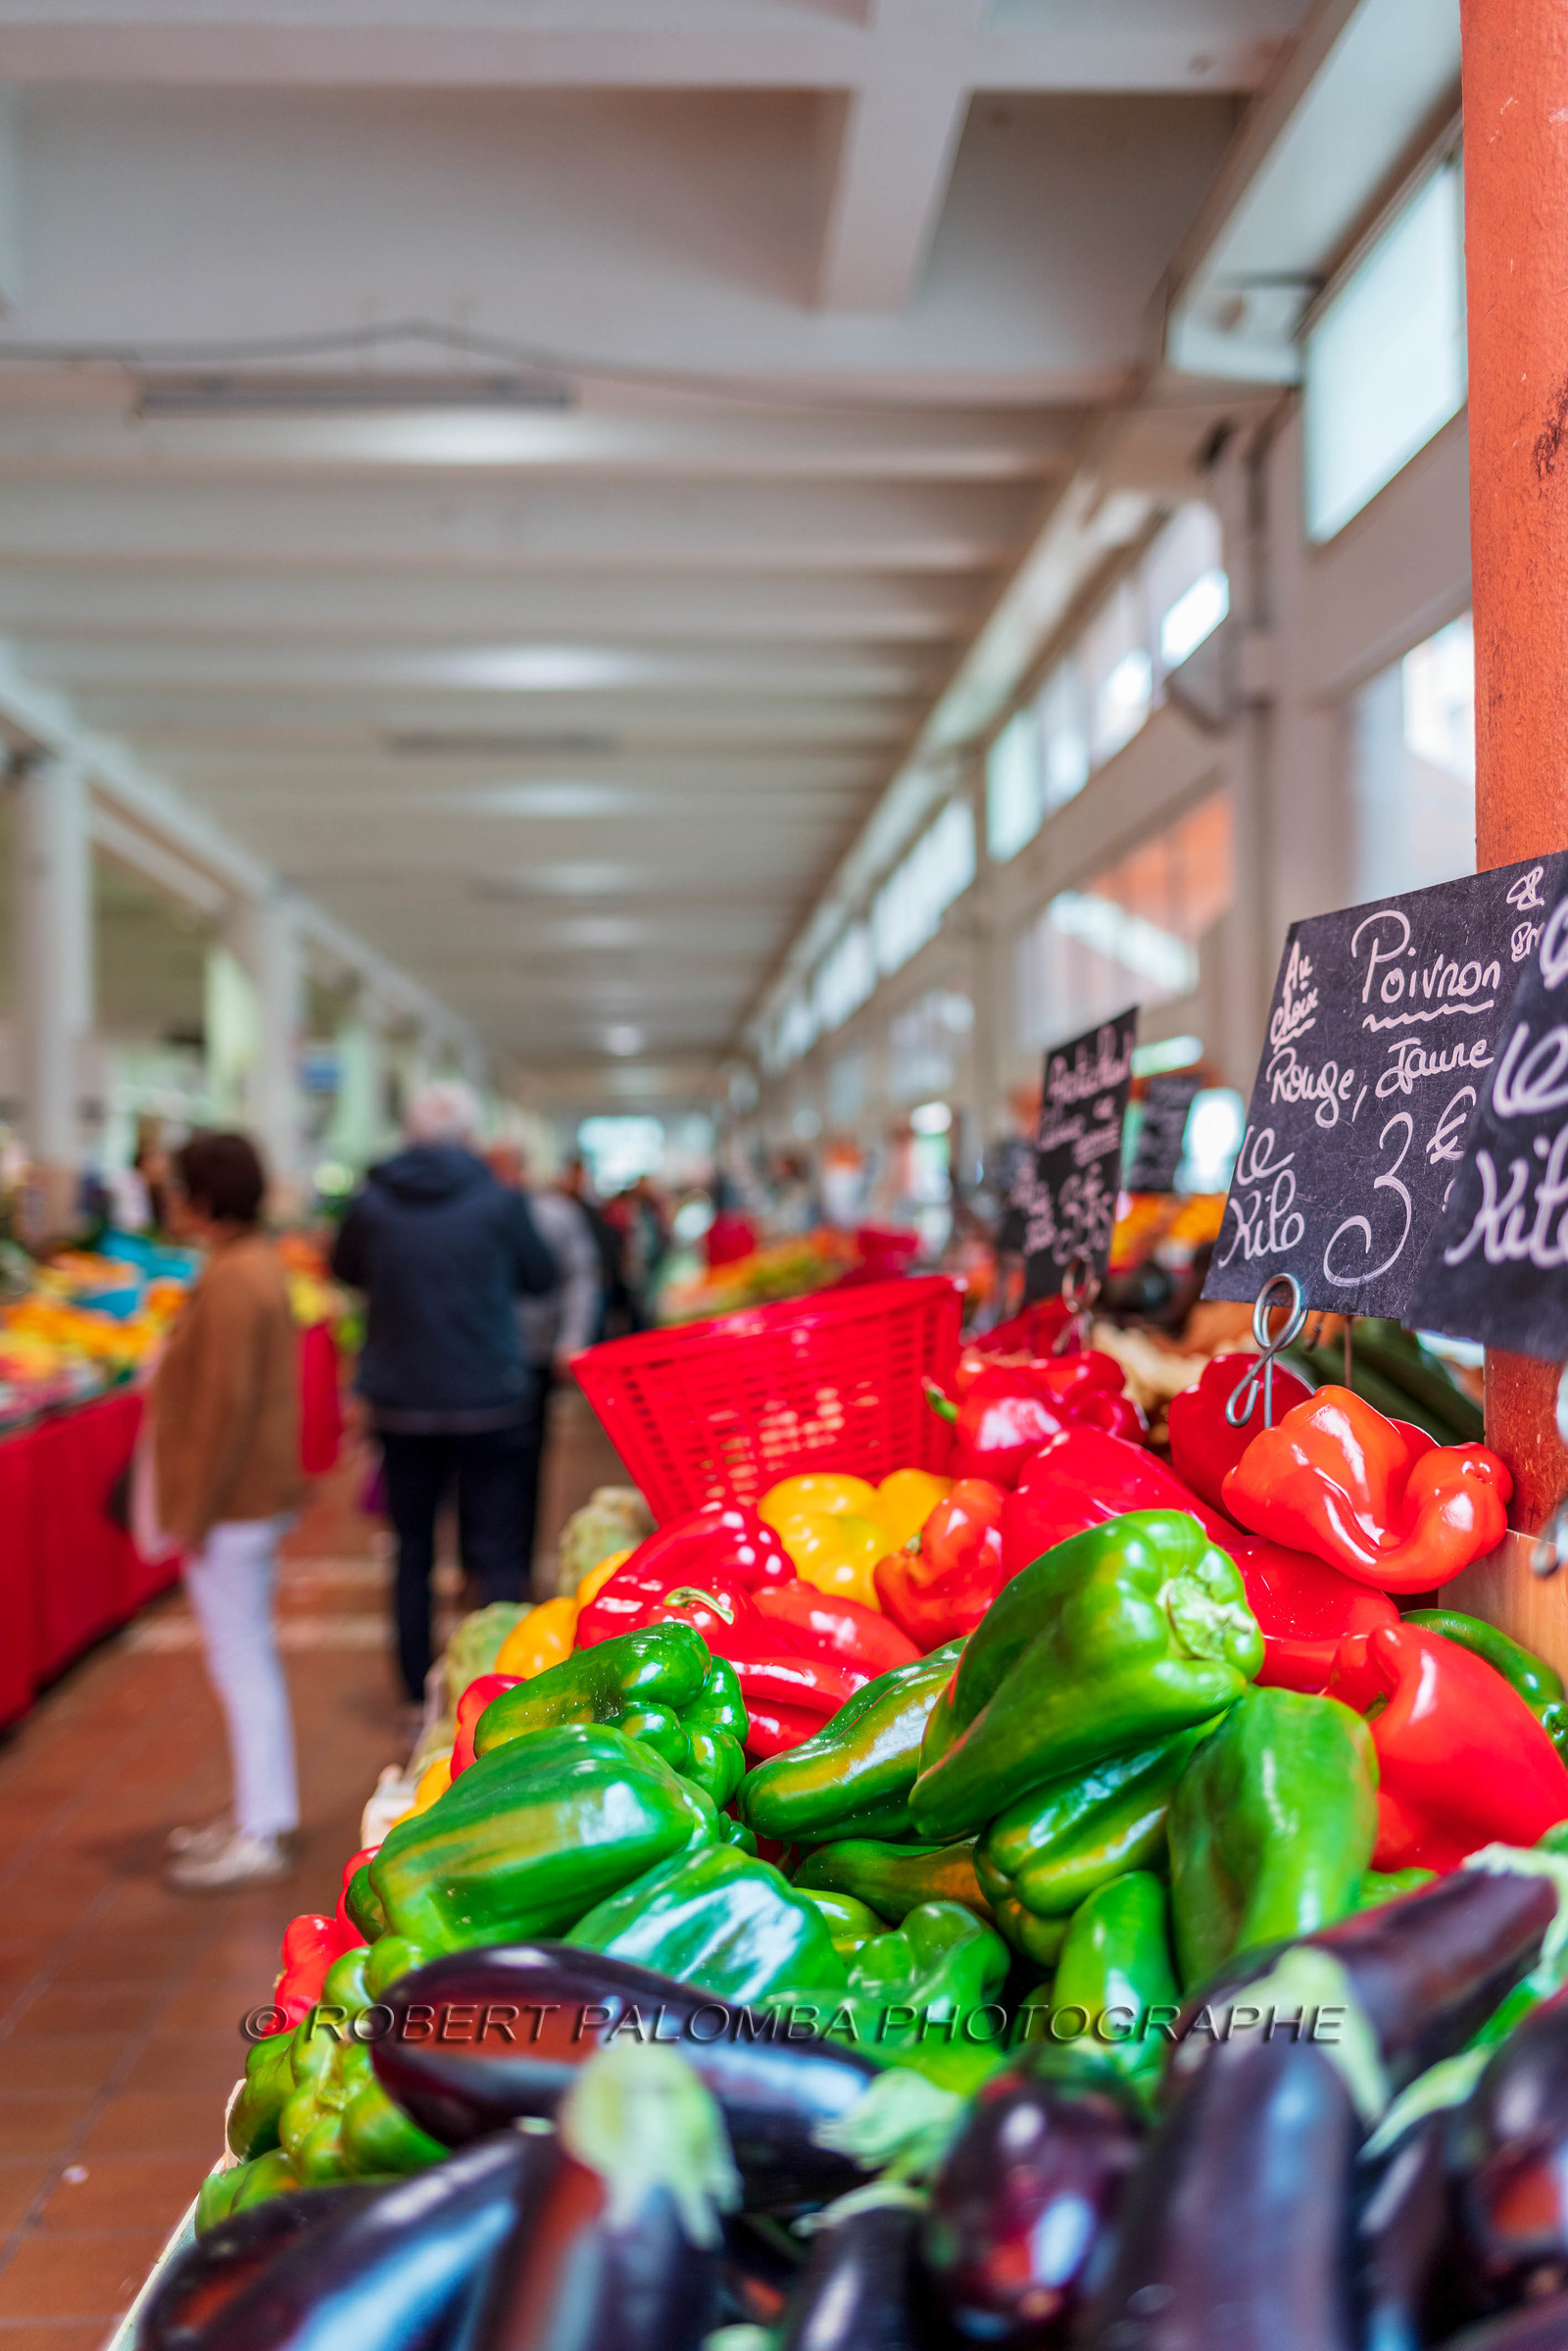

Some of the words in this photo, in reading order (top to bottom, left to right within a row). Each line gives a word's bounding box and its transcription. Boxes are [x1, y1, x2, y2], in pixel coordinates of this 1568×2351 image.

[1351, 909, 1500, 1004] Poivron
[1375, 1037, 1494, 1099] Jaune
[1218, 1168, 1304, 1269] Kilo
[1444, 1121, 1568, 1269] Kil
